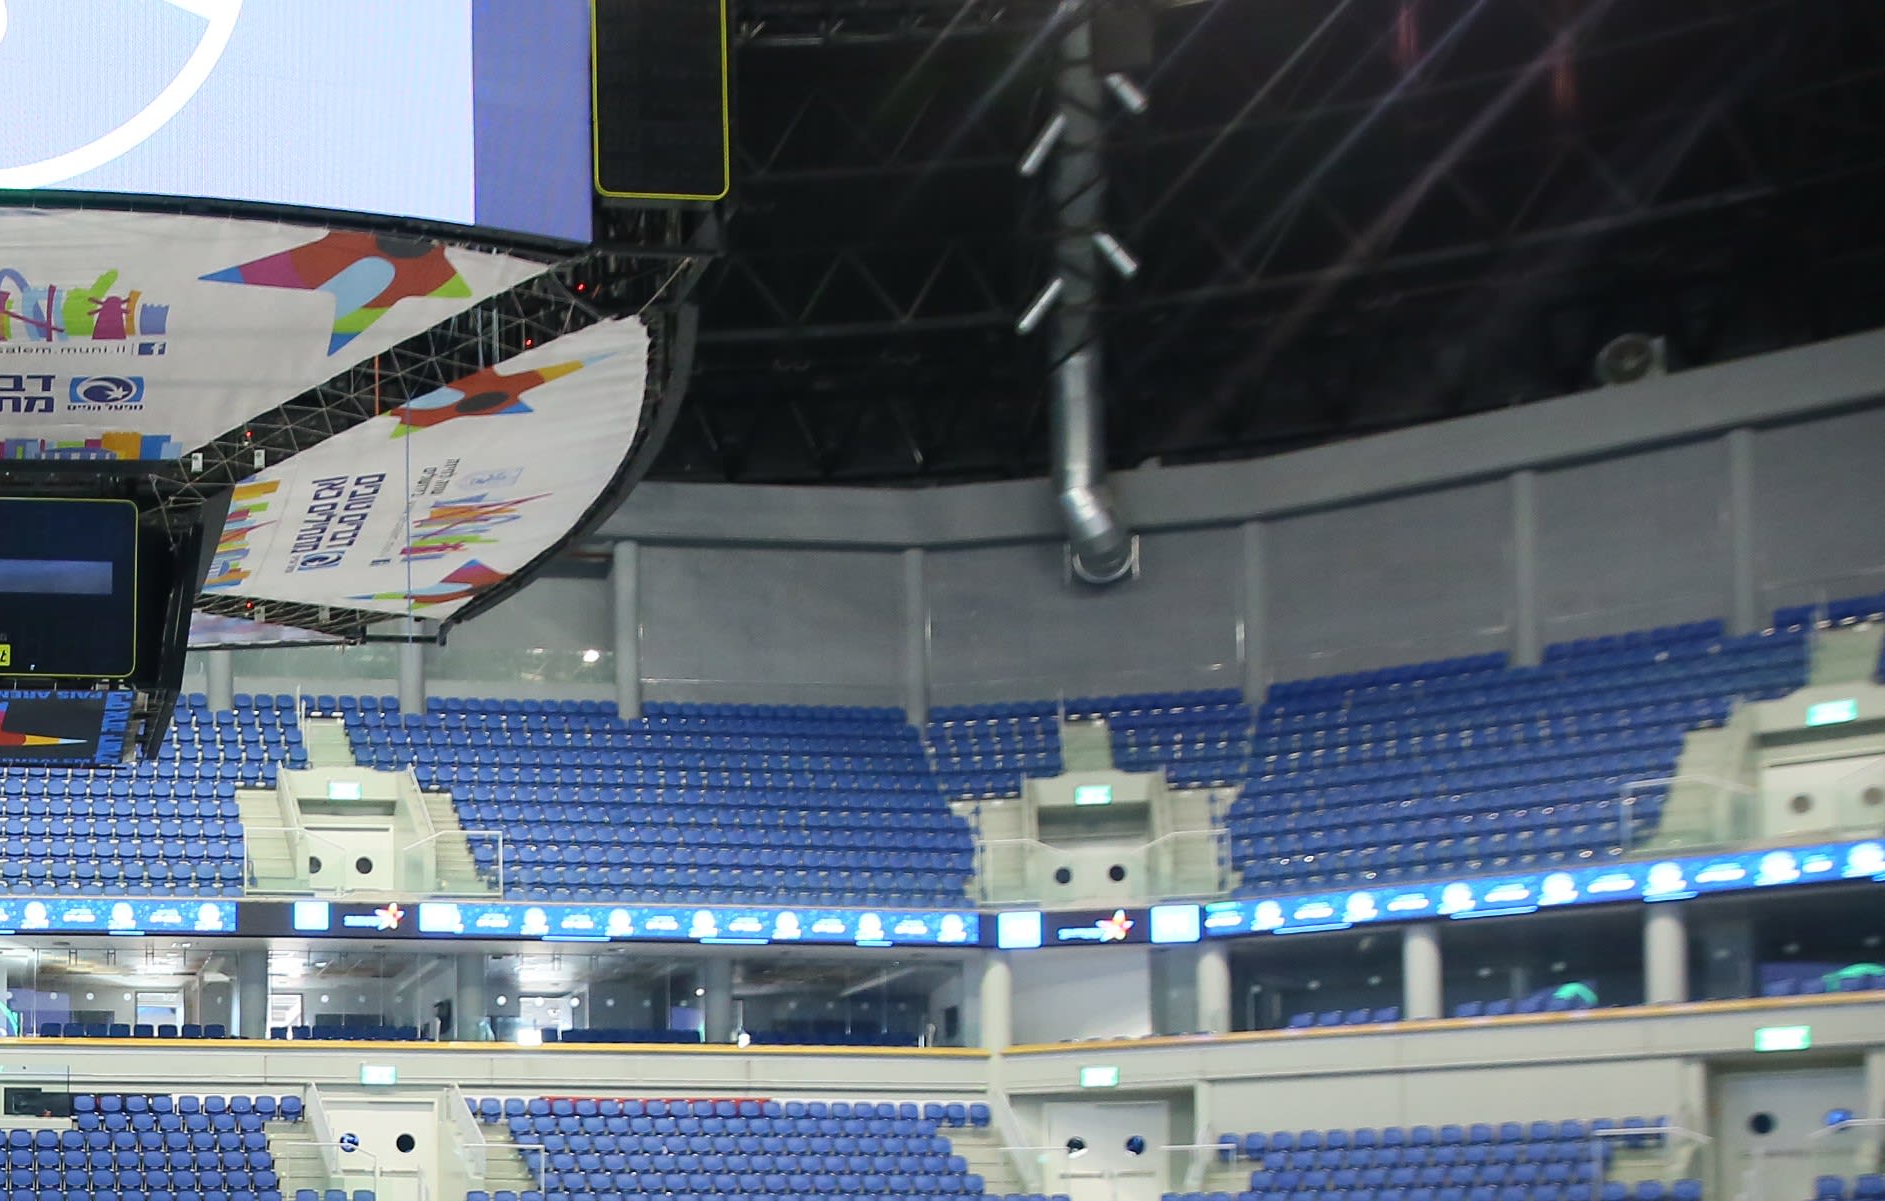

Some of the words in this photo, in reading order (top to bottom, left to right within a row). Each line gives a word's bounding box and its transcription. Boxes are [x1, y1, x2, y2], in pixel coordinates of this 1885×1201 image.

[311, 475, 349, 500] כאן
[344, 473, 386, 511] טובים
[290, 502, 337, 554] מתחילים
[326, 513, 368, 549] דברים
